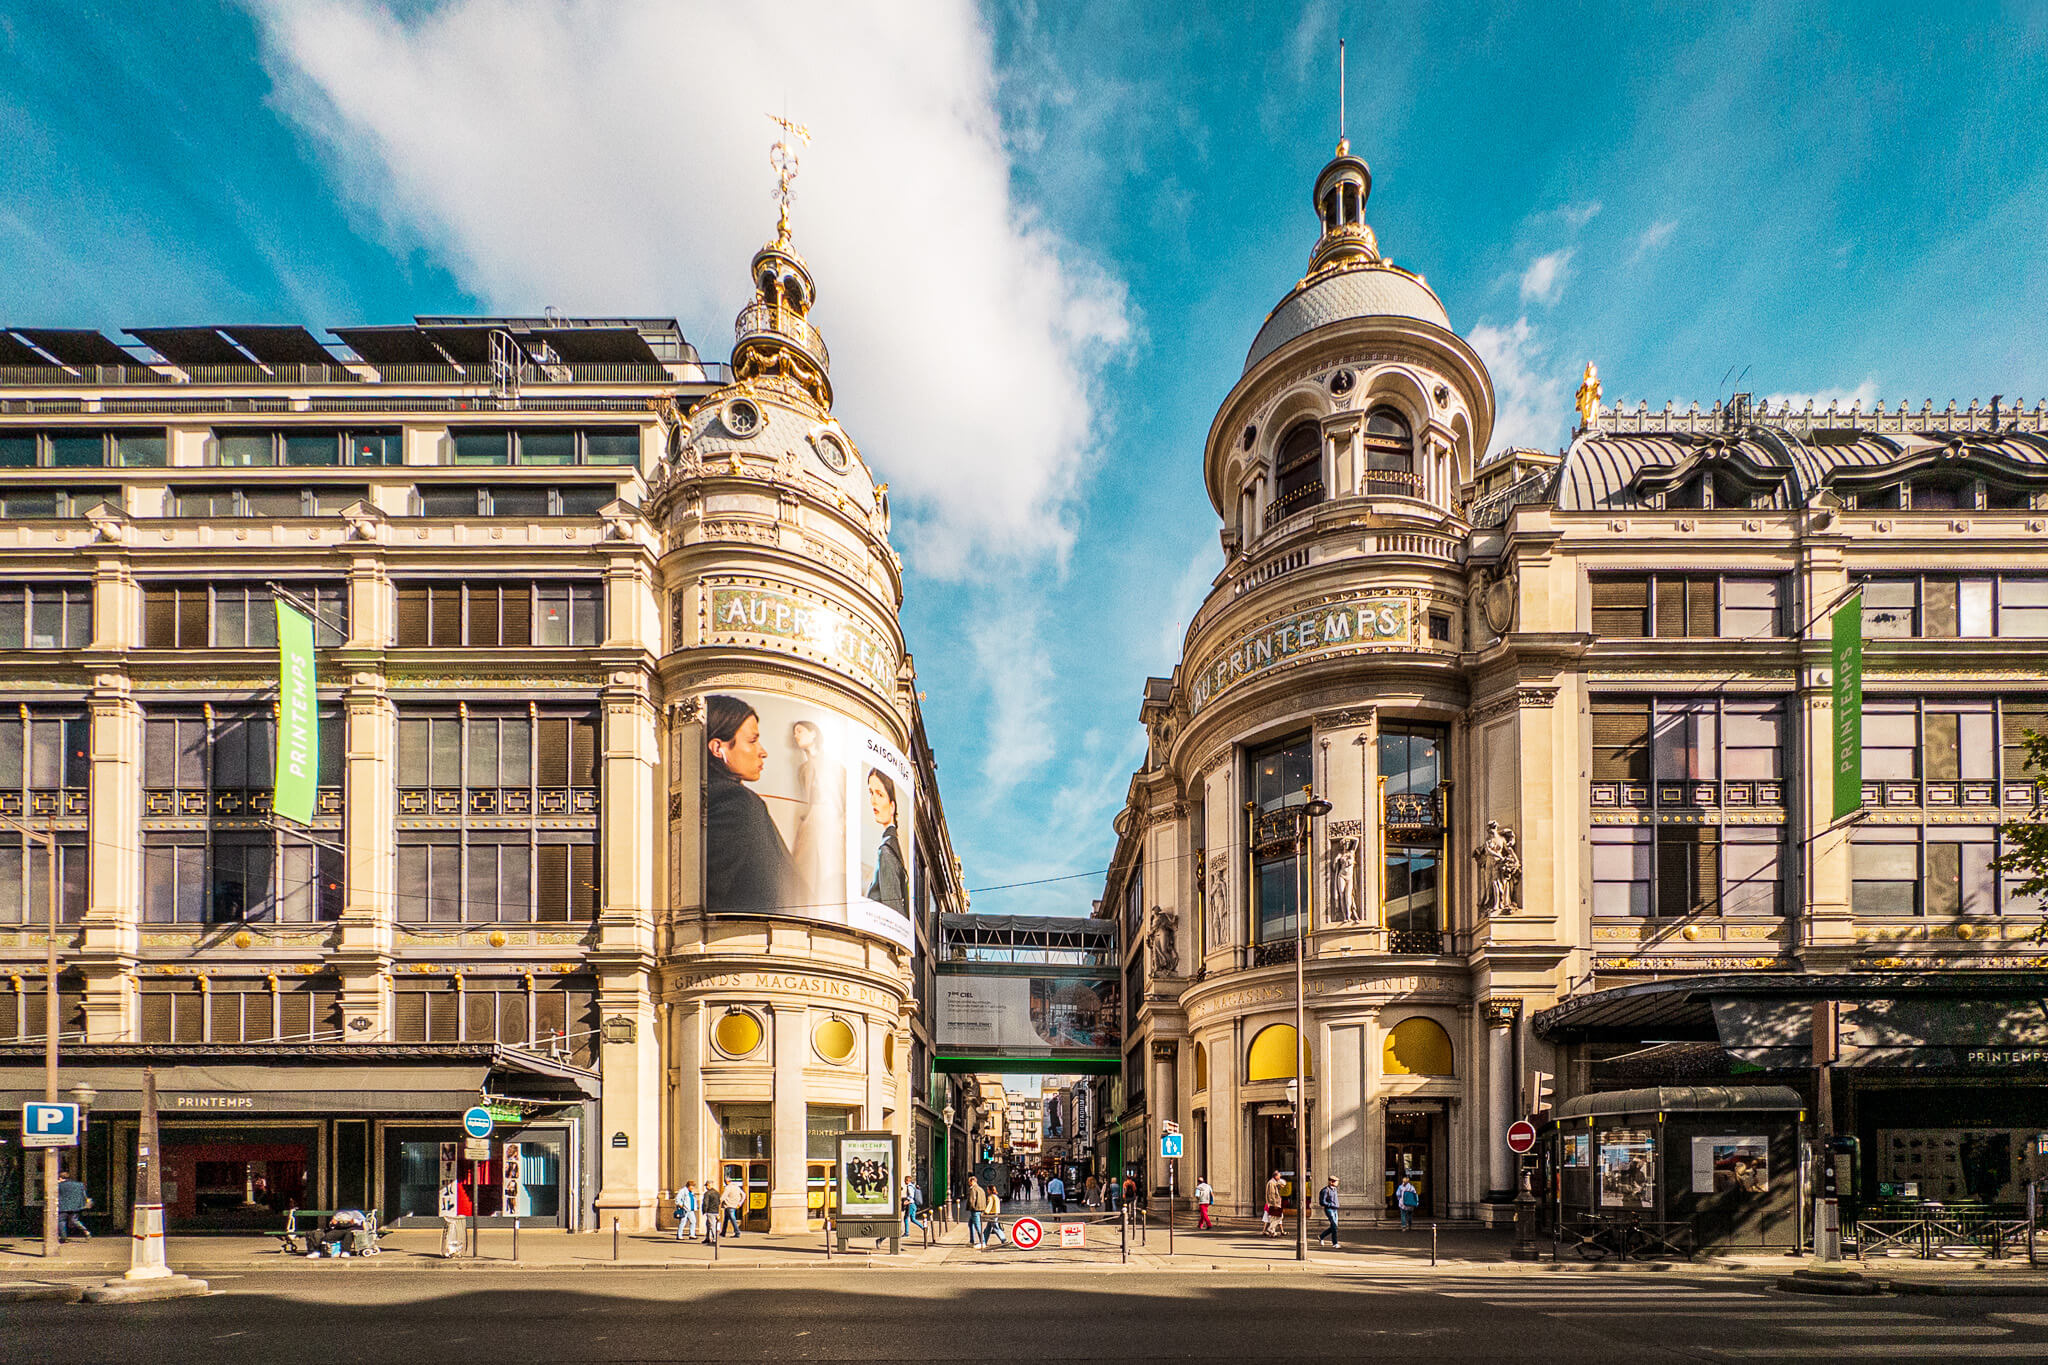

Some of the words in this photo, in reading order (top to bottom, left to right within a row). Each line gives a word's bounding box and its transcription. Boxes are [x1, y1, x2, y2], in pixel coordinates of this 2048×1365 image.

[728, 597, 767, 626] AU
[776, 603, 897, 698] PRNTEM
[1192, 675, 1211, 715] AU
[1217, 607, 1397, 688] PRINTEMPS
[290, 652, 308, 779] PRINTEMPS
[1840, 646, 1854, 774] PRINTEMPS
[867, 739, 898, 768] SAISON
[674, 974, 741, 990] GRANDS
[755, 974, 850, 997] MAGASINS
[859, 987, 876, 1003] DU
[1213, 985, 1285, 1010] MAGASINS
[1302, 980, 1325, 994] DU
[1345, 976, 1456, 993] PRINTEMPS
[1968, 1052, 2048, 1063] PRINTEMPS
[177, 1097, 253, 1107] PRINTEMPS
[37, 1108, 64, 1131] P
